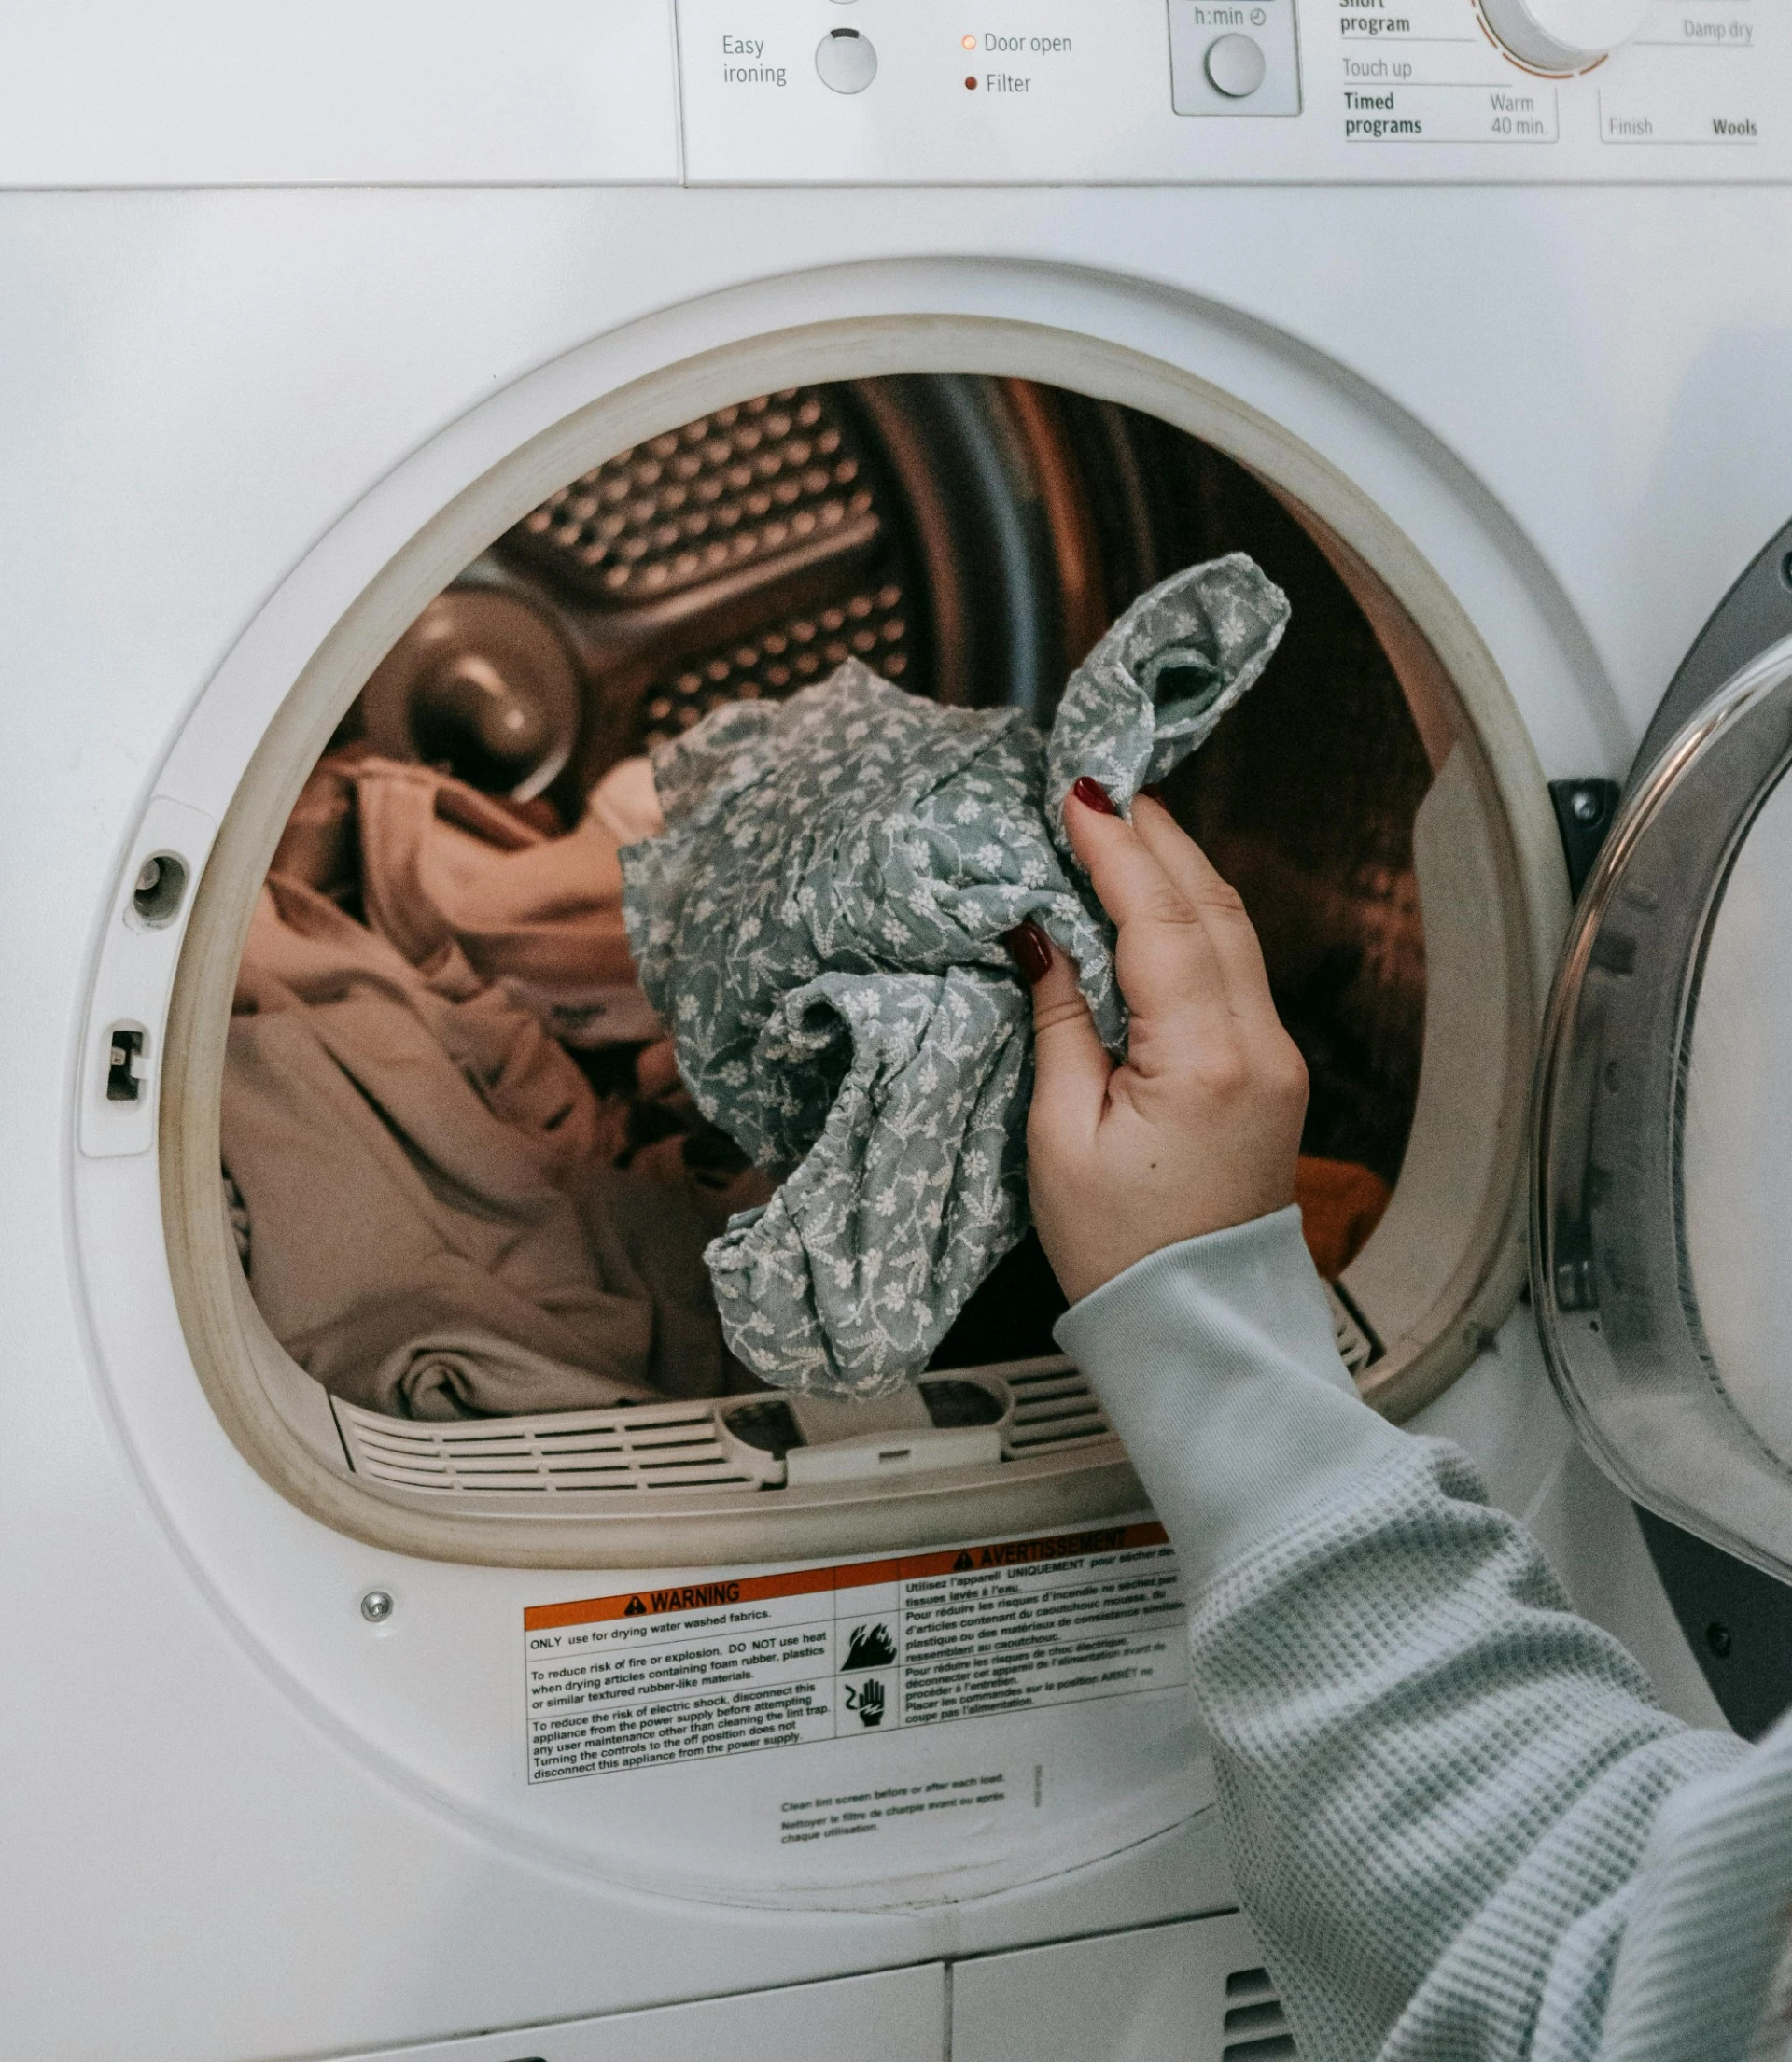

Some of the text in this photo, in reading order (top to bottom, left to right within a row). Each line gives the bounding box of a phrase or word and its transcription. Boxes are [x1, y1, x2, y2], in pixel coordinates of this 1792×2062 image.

[1196, 7, 1244, 25] h:min
[1340, 17, 1411, 35] program
[1684, 20, 1753, 42] Damp dry
[722, 35, 764, 58] Easy
[985, 33, 1072, 56] Door open
[723, 63, 787, 86] ironing
[1342, 59, 1412, 81] Touch up
[987, 74, 1031, 92] Filter
[1344, 93, 1394, 111] Timed
[1491, 94, 1535, 112] Warm
[1345, 118, 1422, 136] programs
[1491, 117, 1548, 135] 40 min.
[1610, 118, 1653, 134] Finish
[1713, 118, 1757, 136] Wools
[980, 1529, 1128, 1565] AVERTISSEMENT
[651, 1583, 740, 1612] WARNING
[530, 1636, 562, 1649] ONLY
[567, 1634, 589, 1645] use
[592, 1632, 607, 1641] for
[611, 1626, 648, 1640] drying
[651, 1621, 681, 1634] water
[684, 1614, 726, 1629] washed
[531, 1672, 545, 1683] To
[548, 1667, 587, 1680] reduce
[589, 1662, 611, 1675] risk
[614, 1660, 625, 1671] of
[629, 1658, 647, 1668] fire
[650, 1657, 662, 1665] or
[727, 1642, 747, 1654] DO
[751, 1637, 777, 1650] NOT
[779, 1636, 799, 1647] use
[802, 1631, 827, 1644] heat
[532, 1684, 562, 1695] when
[565, 1678, 601, 1691] drying
[604, 1672, 645, 1685] articles
[649, 1663, 707, 1679] containing
[710, 1659, 738, 1670] foam
[782, 1647, 825, 1662] plastics
[532, 1701, 544, 1710] or
[546, 1694, 585, 1707] similar
[588, 1686, 635, 1702] textured
[637, 1677, 698, 1695] rubber-like
[532, 1721, 547, 1732] To
[550, 1717, 589, 1730] reduce
[592, 1713, 609, 1723] the
[612, 1708, 634, 1720] risk
[637, 1706, 648, 1717] of
[650, 1701, 691, 1715] electric
[733, 1685, 792, 1703] disconnect
[794, 1682, 816, 1694] this
[532, 1695, 812, 1746] appliance from the power supply before attempting
[533, 1746, 553, 1757] any
[556, 1742, 581, 1753] user
[584, 1731, 656, 1748] maintenance
[658, 1726, 688, 1738] other
[691, 1722, 714, 1733] than
[718, 1715, 763, 1729] cleaning
[766, 1711, 784, 1722] the
[786, 1706, 804, 1718] lint
[533, 1719, 797, 1768] Turning the controls to the off position does not
[534, 1760, 595, 1779] disconnect
[598, 1759, 620, 1770] this
[622, 1751, 676, 1768] appliance
[679, 1747, 704, 1758] from
[707, 1743, 724, 1754] the
[727, 1739, 760, 1753] power
[781, 1802, 812, 1813] Clean
[815, 1796, 833, 1808] lint
[834, 1793, 872, 1805] screen
[875, 1788, 908, 1800] before
[911, 1786, 923, 1795] or
[926, 1781, 949, 1792] after
[951, 1775, 978, 1788] each
